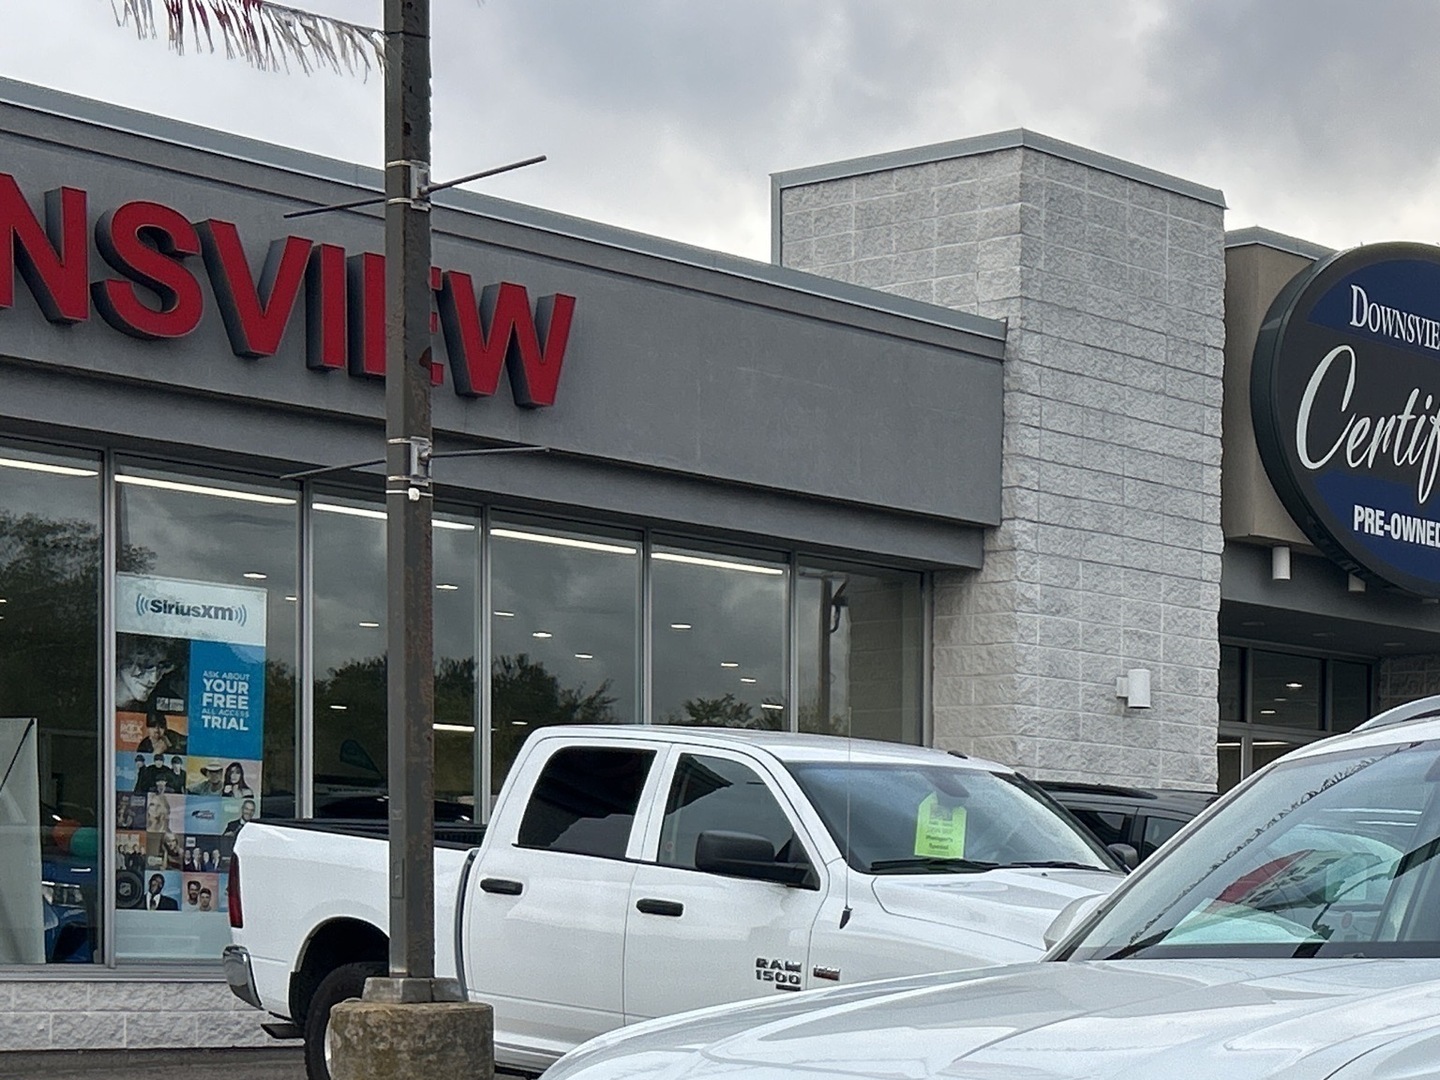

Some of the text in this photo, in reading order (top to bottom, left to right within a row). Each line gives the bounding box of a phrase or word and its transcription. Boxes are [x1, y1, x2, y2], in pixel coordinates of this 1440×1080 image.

[203, 670, 250, 681] ASK ABOUT
[203, 678, 250, 695] YOUR
[202, 692, 249, 710] FREE
[201, 714, 249, 731] TRIAL
[755, 969, 802, 986] 1500
